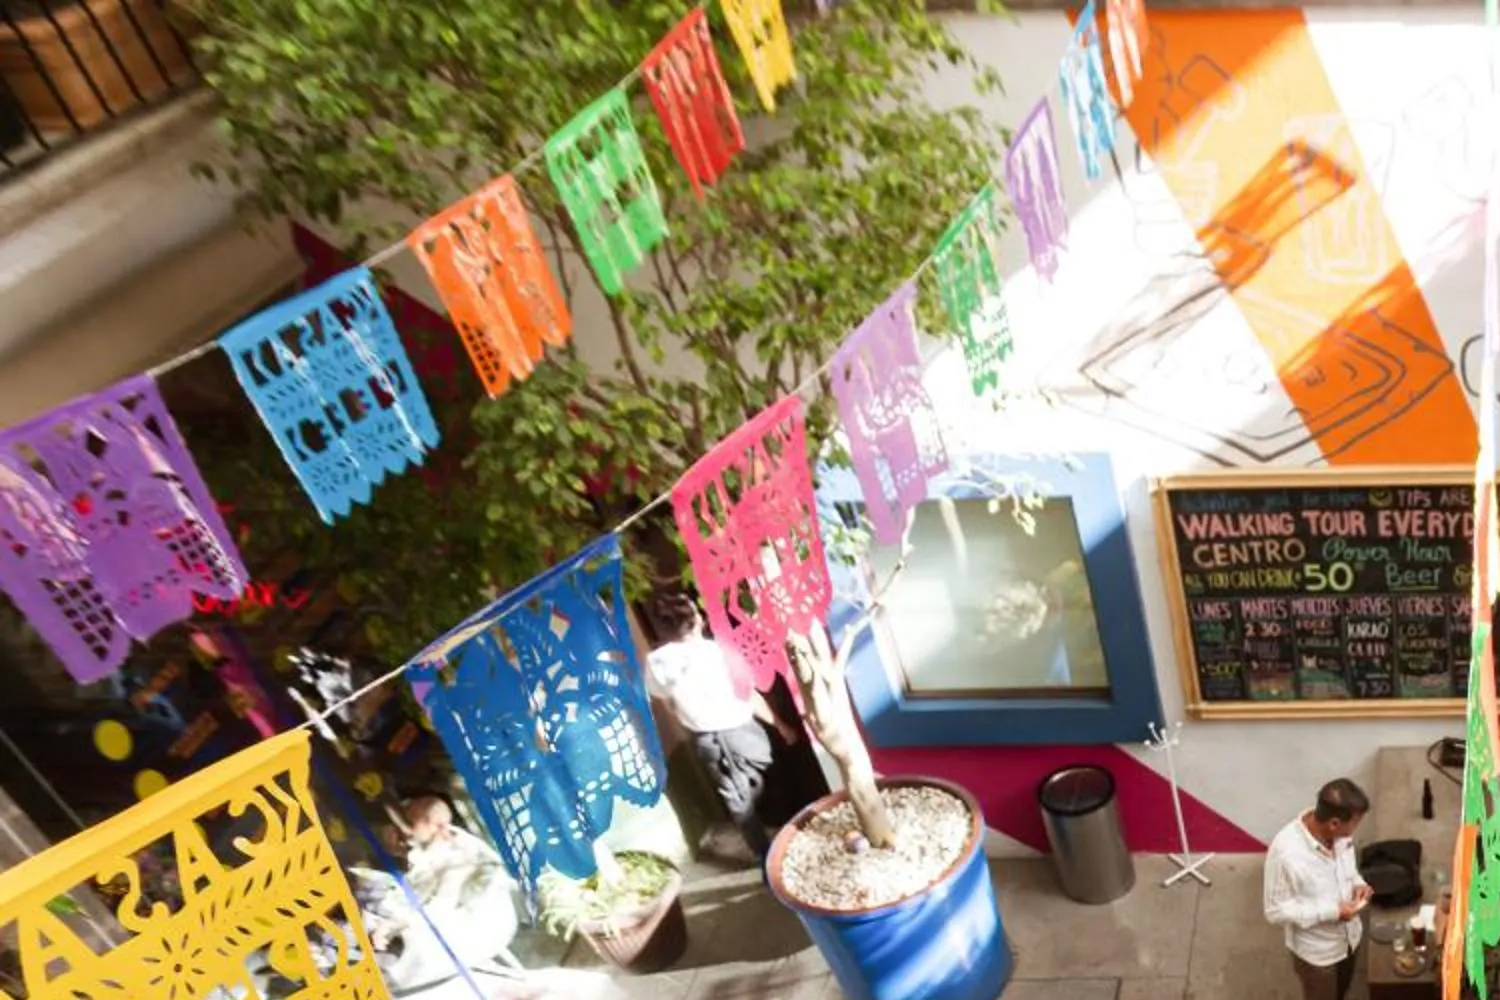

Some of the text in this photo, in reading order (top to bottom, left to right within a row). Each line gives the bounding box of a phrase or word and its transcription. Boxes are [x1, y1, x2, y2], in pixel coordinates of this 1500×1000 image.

[1177, 512, 1297, 541] WALKING
[1302, 510, 1367, 537] TOUR
[1193, 538, 1306, 568] CENTRO
[1385, 562, 1443, 588] Beer
[1241, 597, 1288, 620] MARTES
[1345, 595, 1393, 616] JUEVES
[1397, 595, 1446, 616] VIERNES
